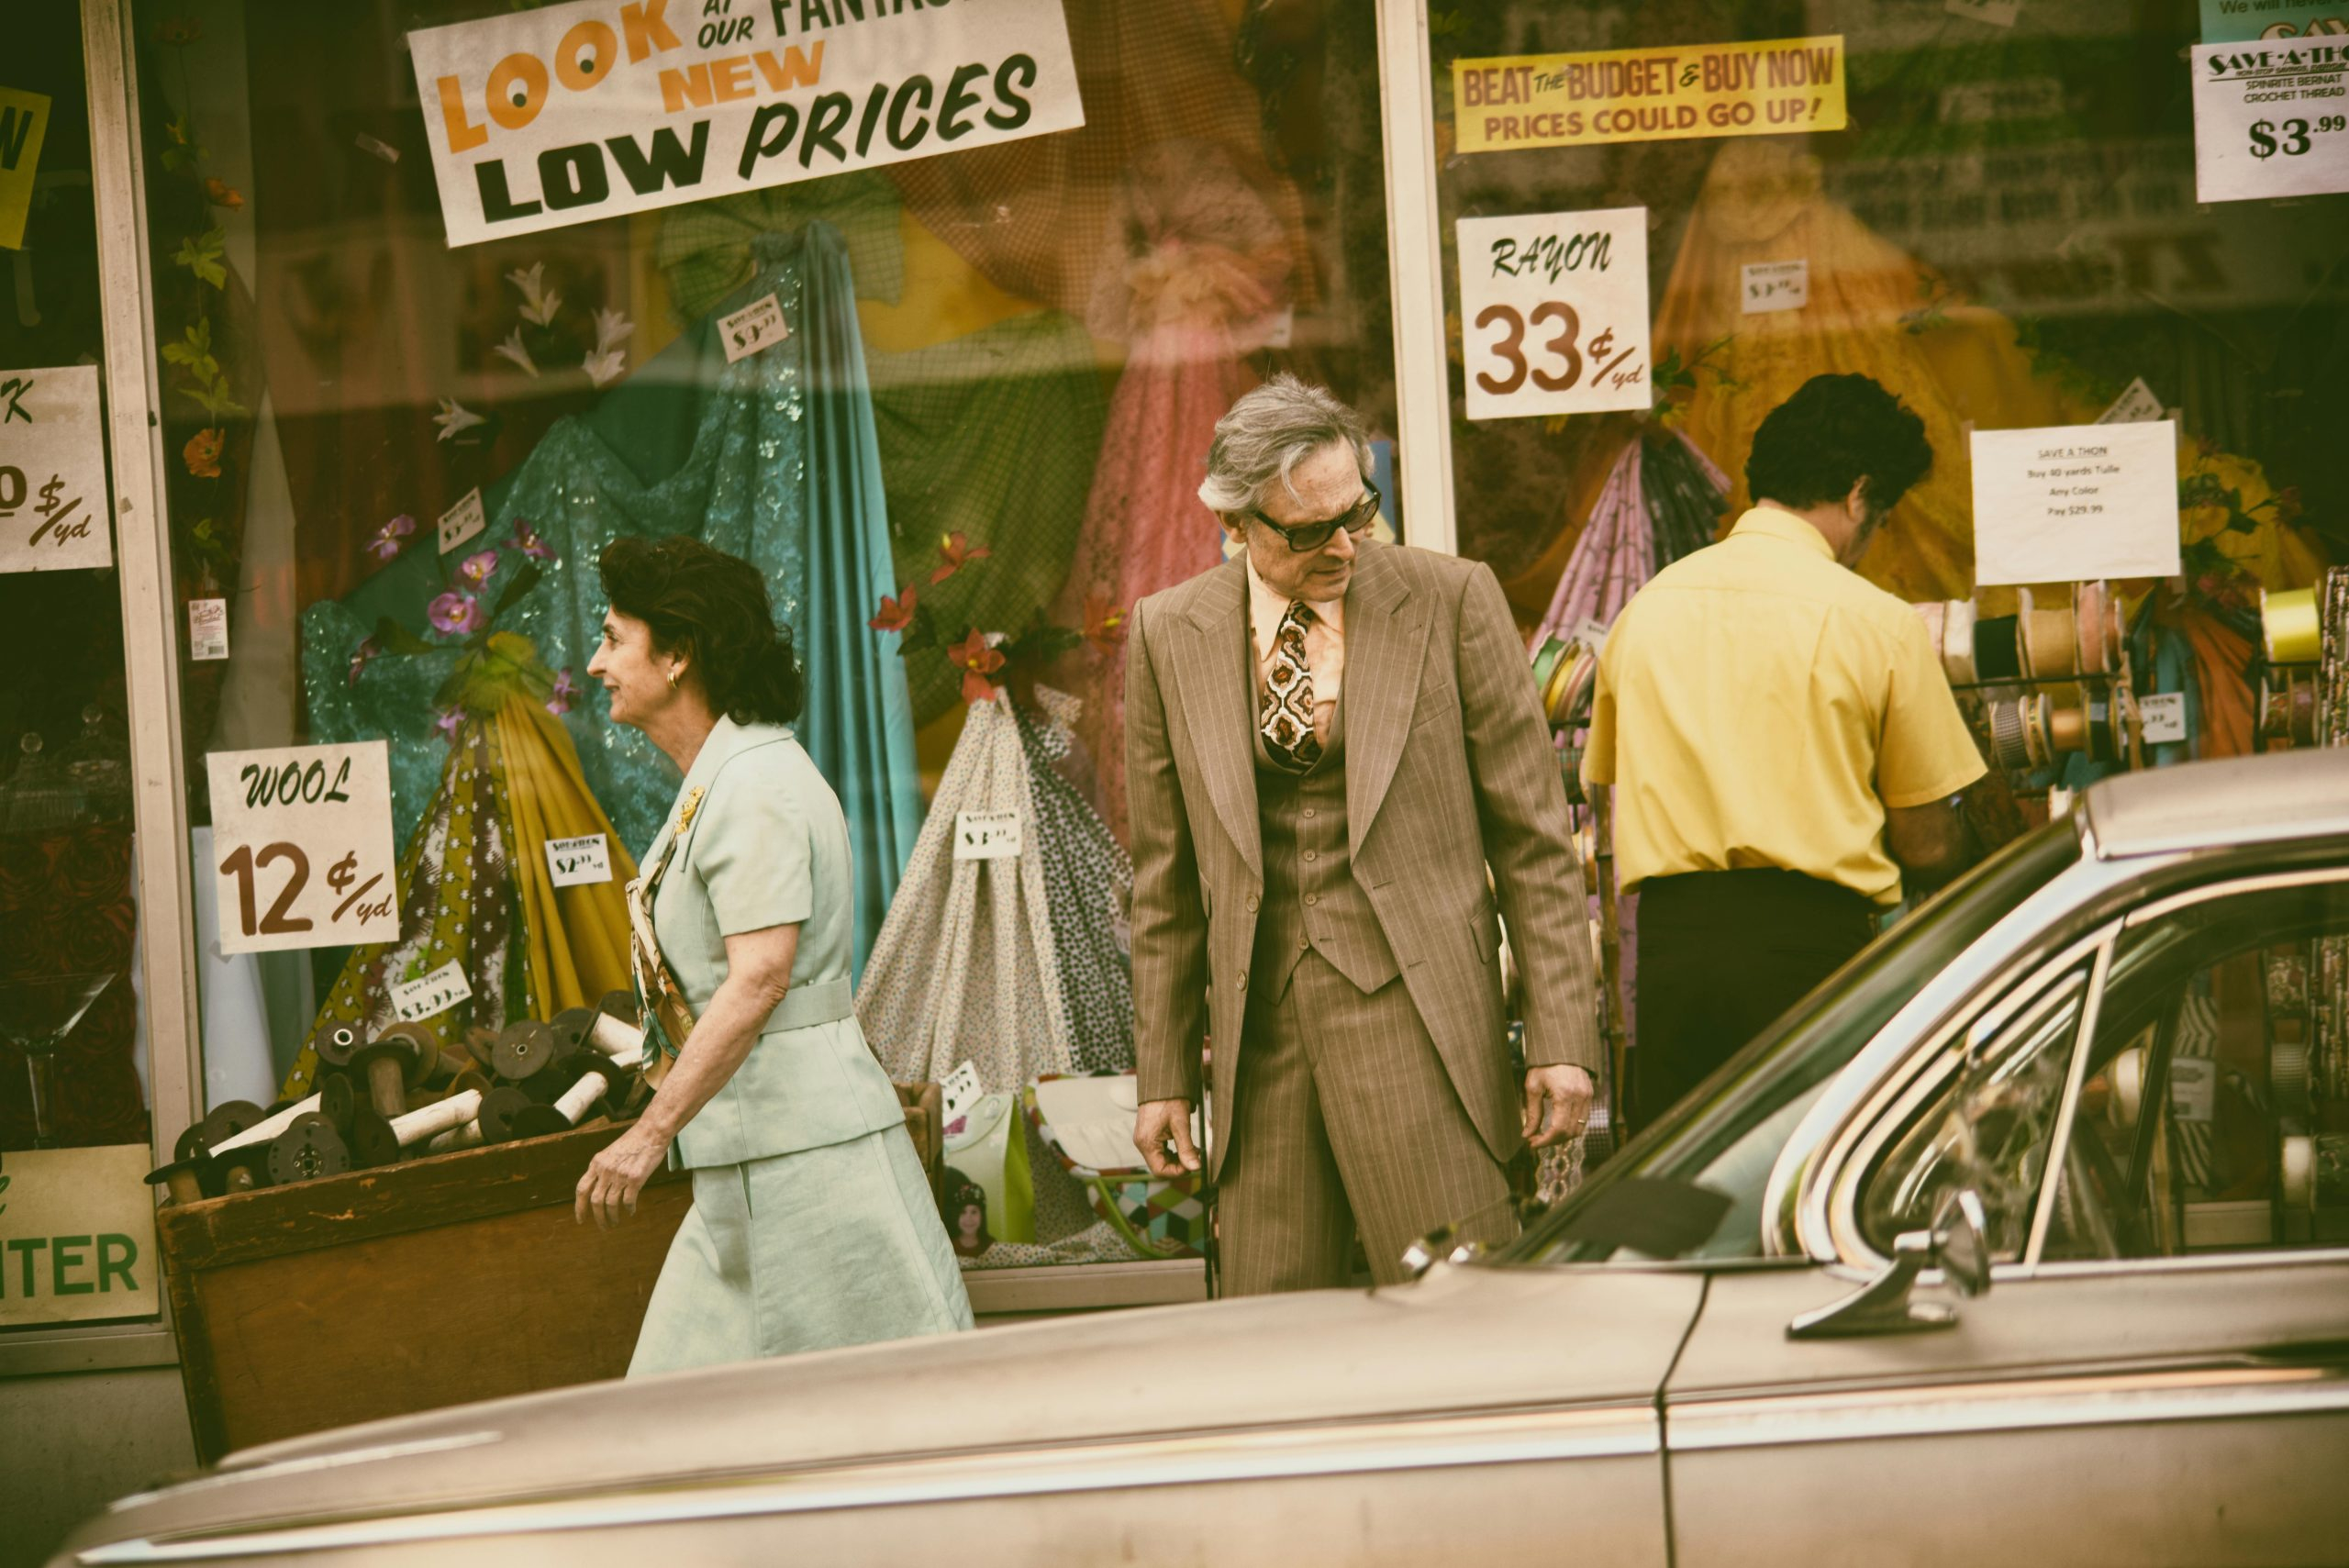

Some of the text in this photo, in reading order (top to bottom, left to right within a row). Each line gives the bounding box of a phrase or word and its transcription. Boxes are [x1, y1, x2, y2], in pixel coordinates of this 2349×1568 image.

[698, 16, 755, 50] OUR
[436, 0, 682, 154] LOOK
[658, 39, 825, 114] NEW
[1464, 47, 1834, 107] BEAT THE BUDGET & BUY NOW
[2244, 87, 2345, 103] CROCHET THREAD
[2246, 73, 2342, 90] SPINRITE BERNAT
[473, 53, 1037, 224] LOW PRICES
[1485, 97, 1823, 141] PRICES COULD GO UP!
[2249, 115, 2346, 161] $3.99
[1491, 231, 1612, 285] RAYON
[2038, 447, 2108, 458] SAVE A THON
[2065, 467, 2092, 477] yards
[2047, 507, 2065, 517] Pay
[2049, 486, 2099, 497] Any Color
[240, 756, 351, 808] WOOL
[0, 1233, 139, 1299] TER
